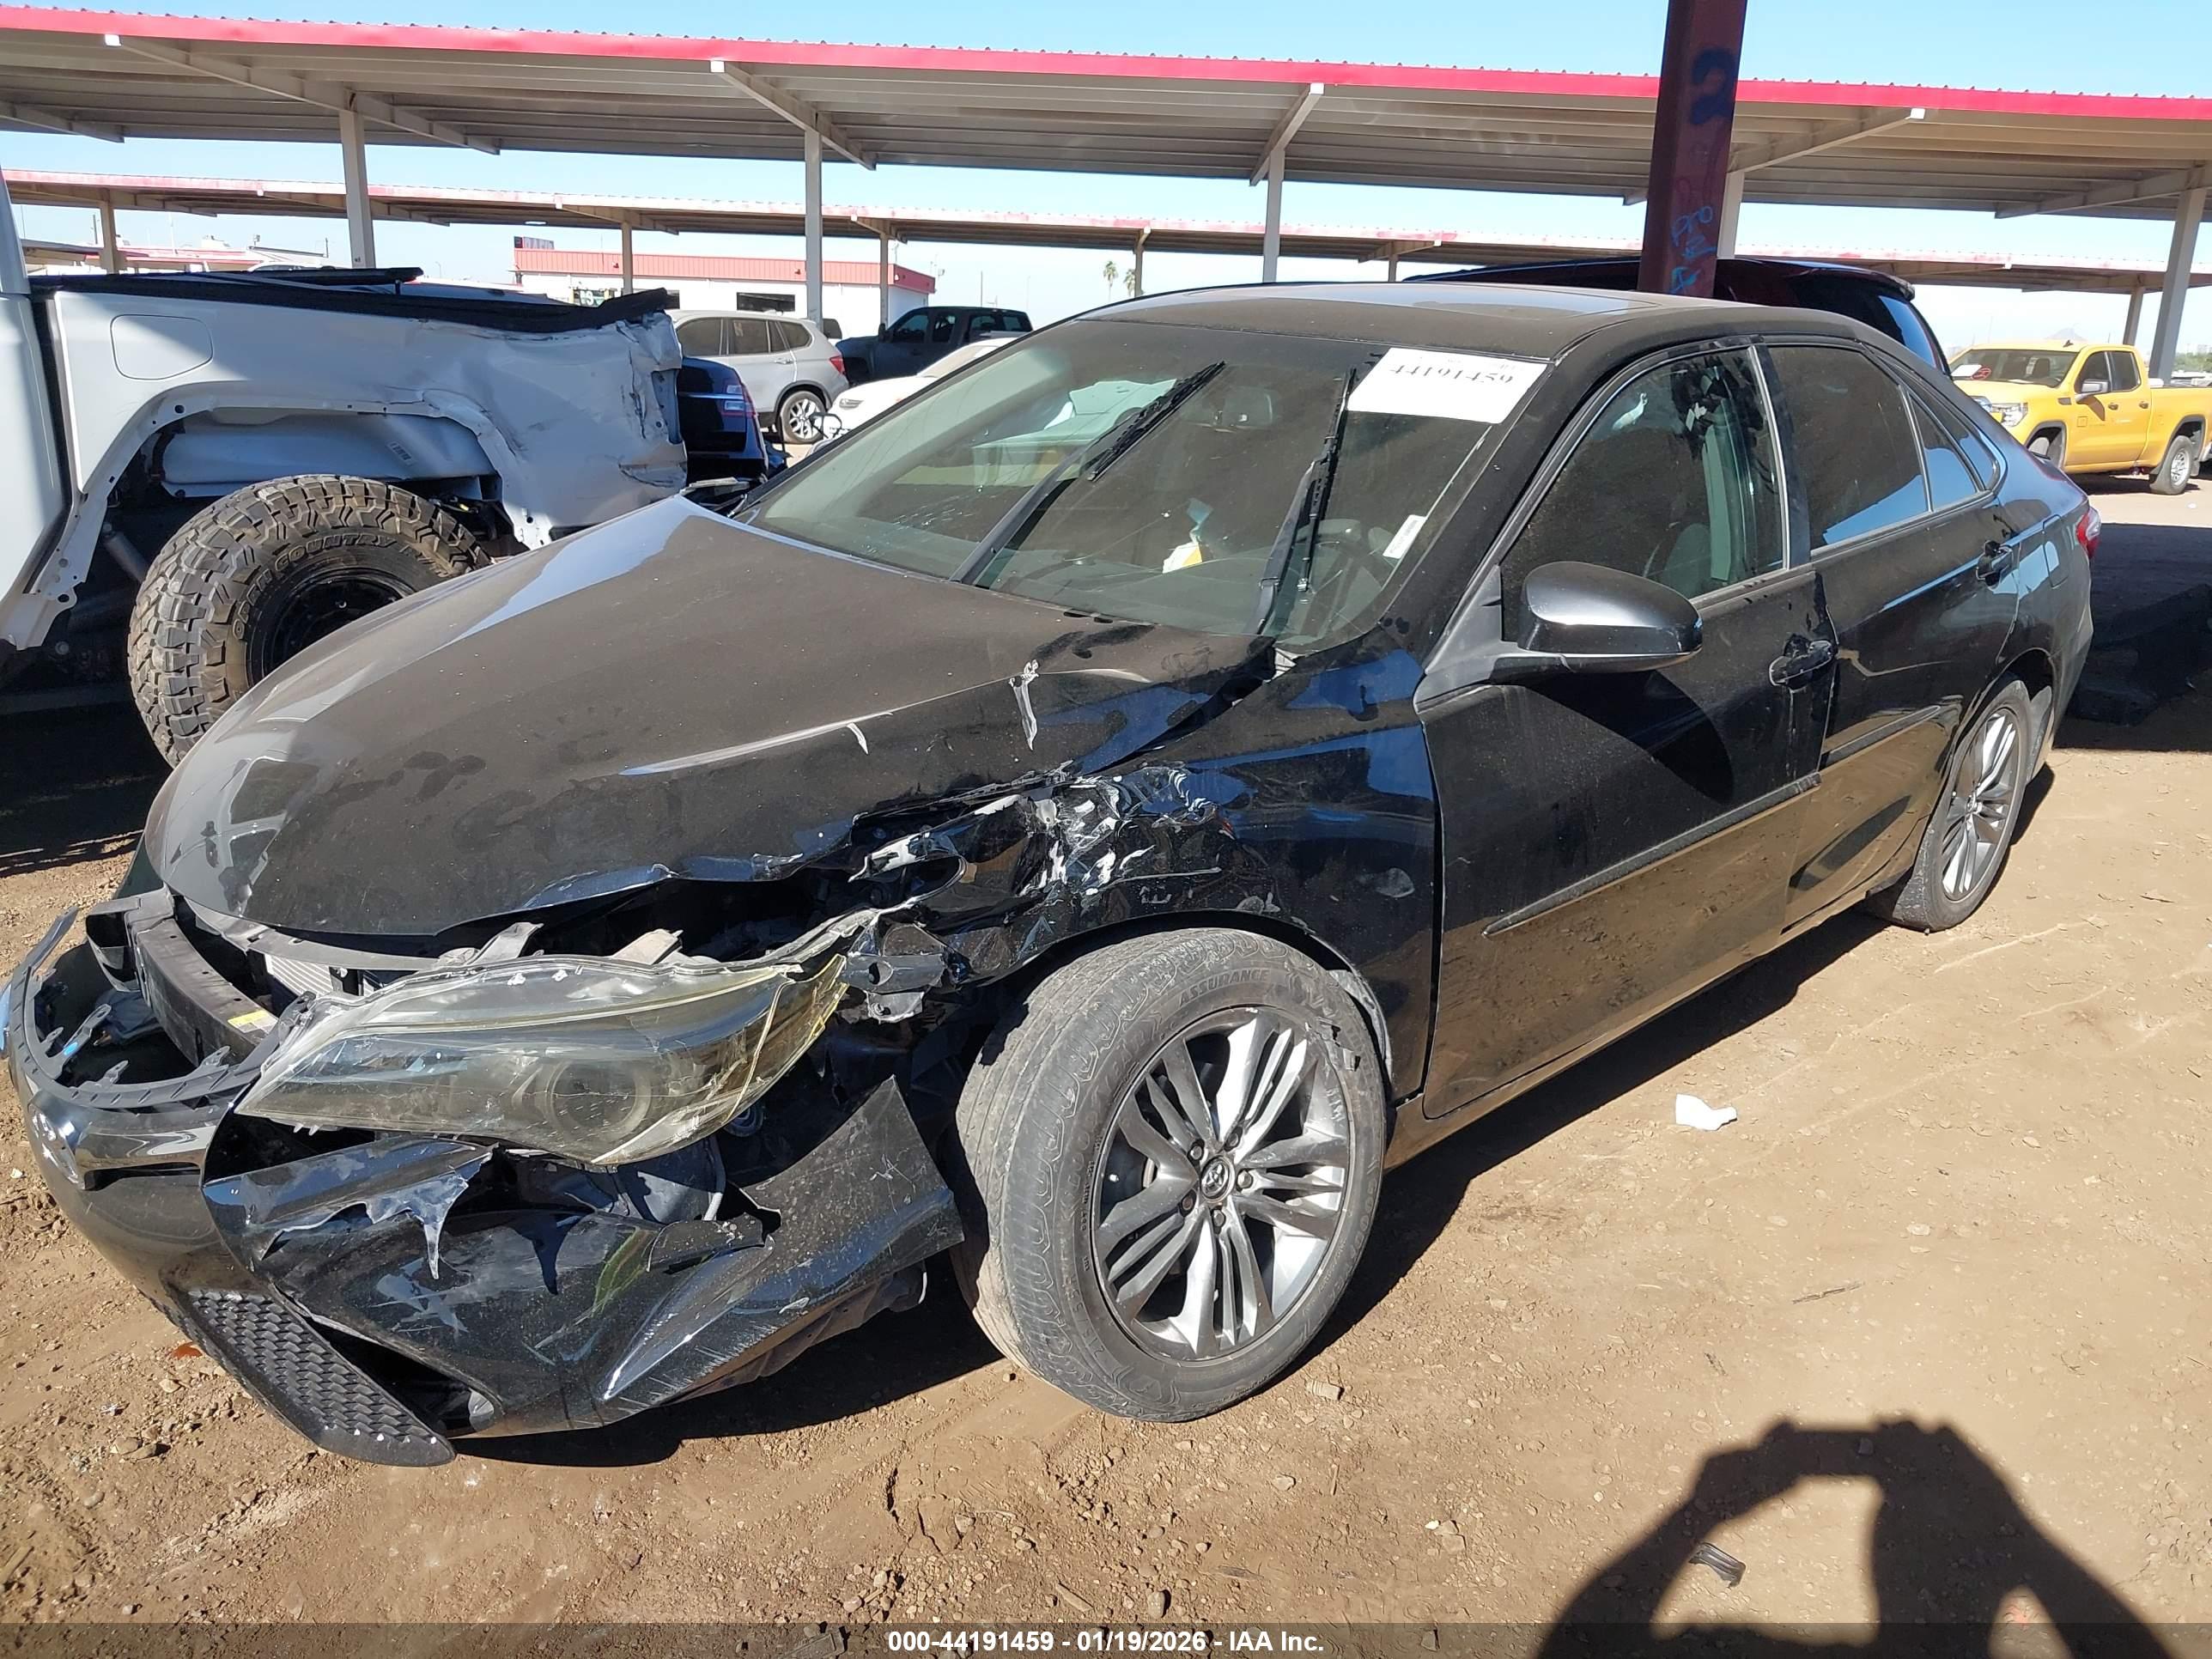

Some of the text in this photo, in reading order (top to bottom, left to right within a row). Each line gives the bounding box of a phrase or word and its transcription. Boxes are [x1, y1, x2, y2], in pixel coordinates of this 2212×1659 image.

[233, 568, 273, 640] OPEN
[275, 533, 397, 572] COUNTRY
[1179, 968, 1268, 1006] ASSURANCE
